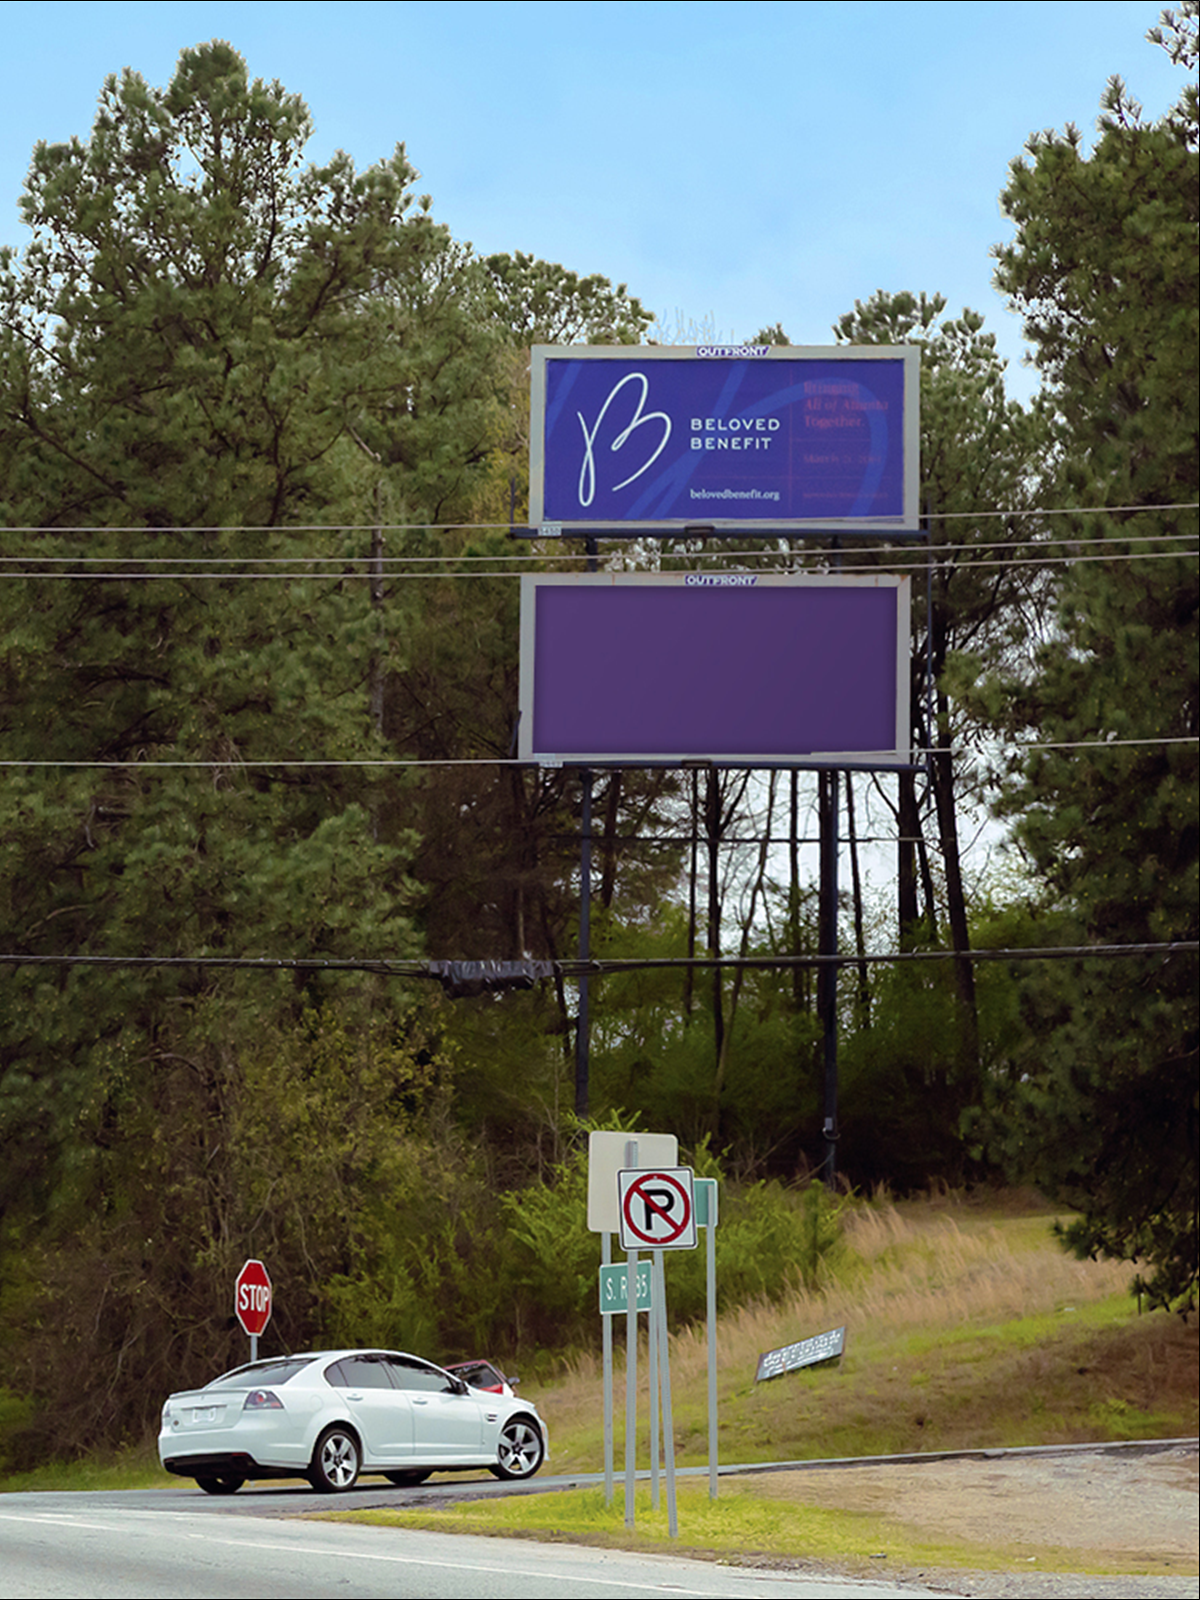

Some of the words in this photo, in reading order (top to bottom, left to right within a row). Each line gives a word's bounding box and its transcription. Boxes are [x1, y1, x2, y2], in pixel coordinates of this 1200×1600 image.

[698, 346, 766, 357] OUTFRONT
[691, 418, 780, 431] BELOVED
[691, 437, 772, 450] BENEFIT
[690, 488, 780, 501] belovedbenefit.org
[687, 575, 755, 586] OUTFRONT
[240, 1283, 270, 1312] STOP
